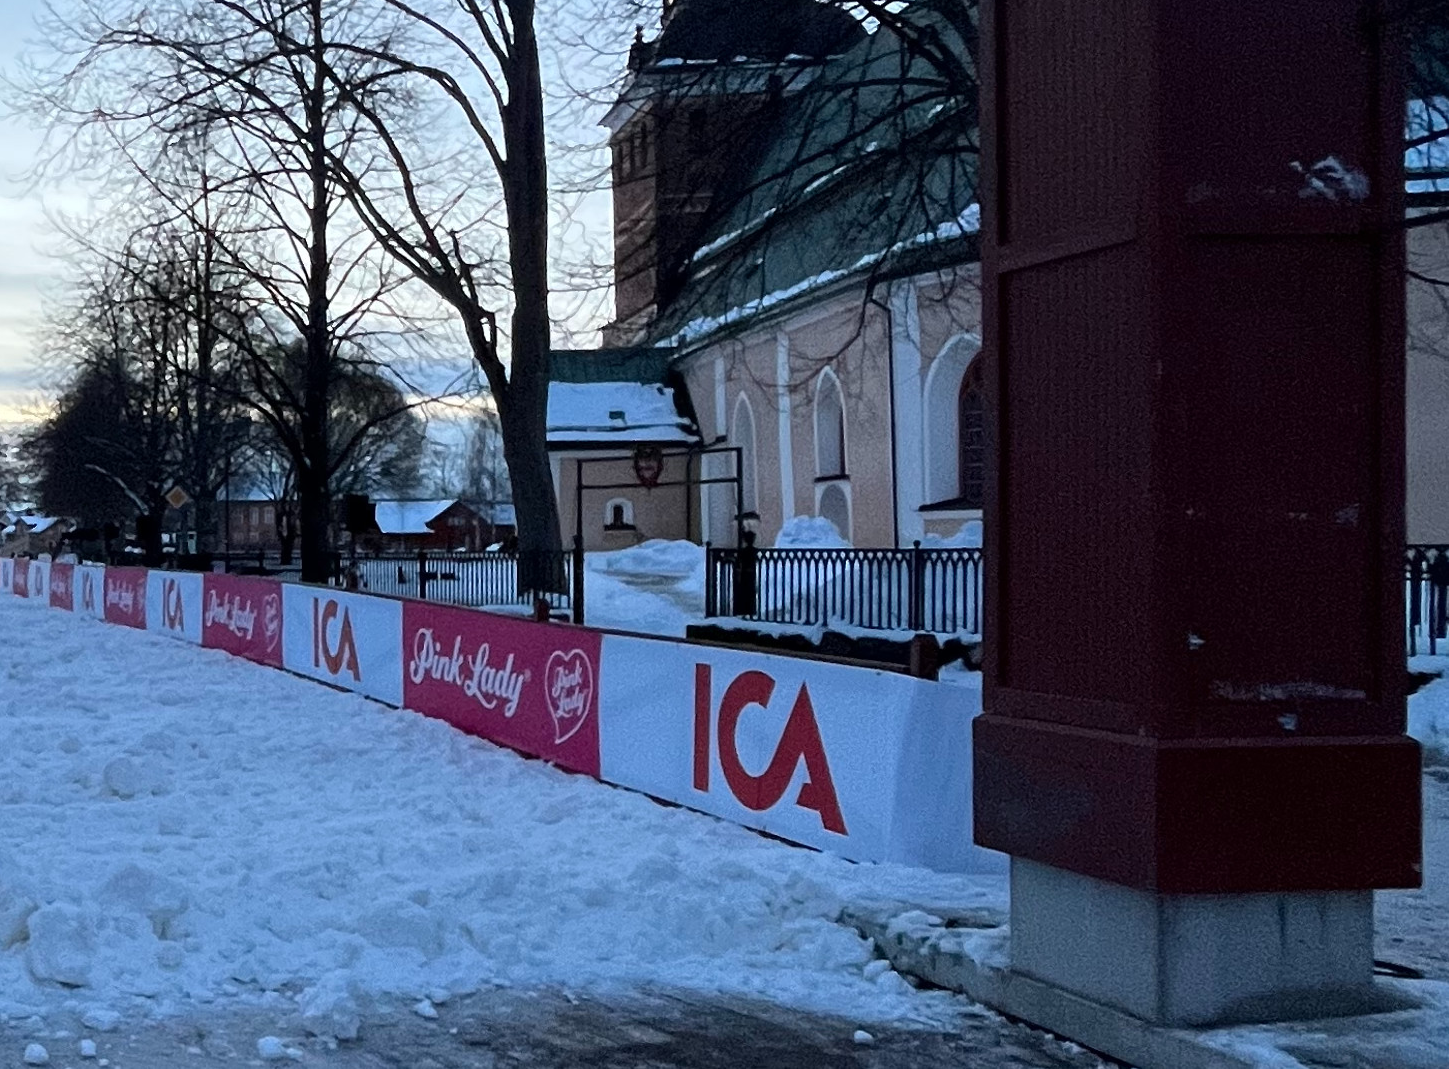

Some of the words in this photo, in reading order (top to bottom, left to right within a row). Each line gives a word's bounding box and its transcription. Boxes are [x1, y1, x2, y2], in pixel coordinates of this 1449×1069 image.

[313, 598, 361, 682] ICA
[410, 628, 465, 684] Pink
[463, 643, 526, 718] Lady
[693, 662, 849, 836] ICA
